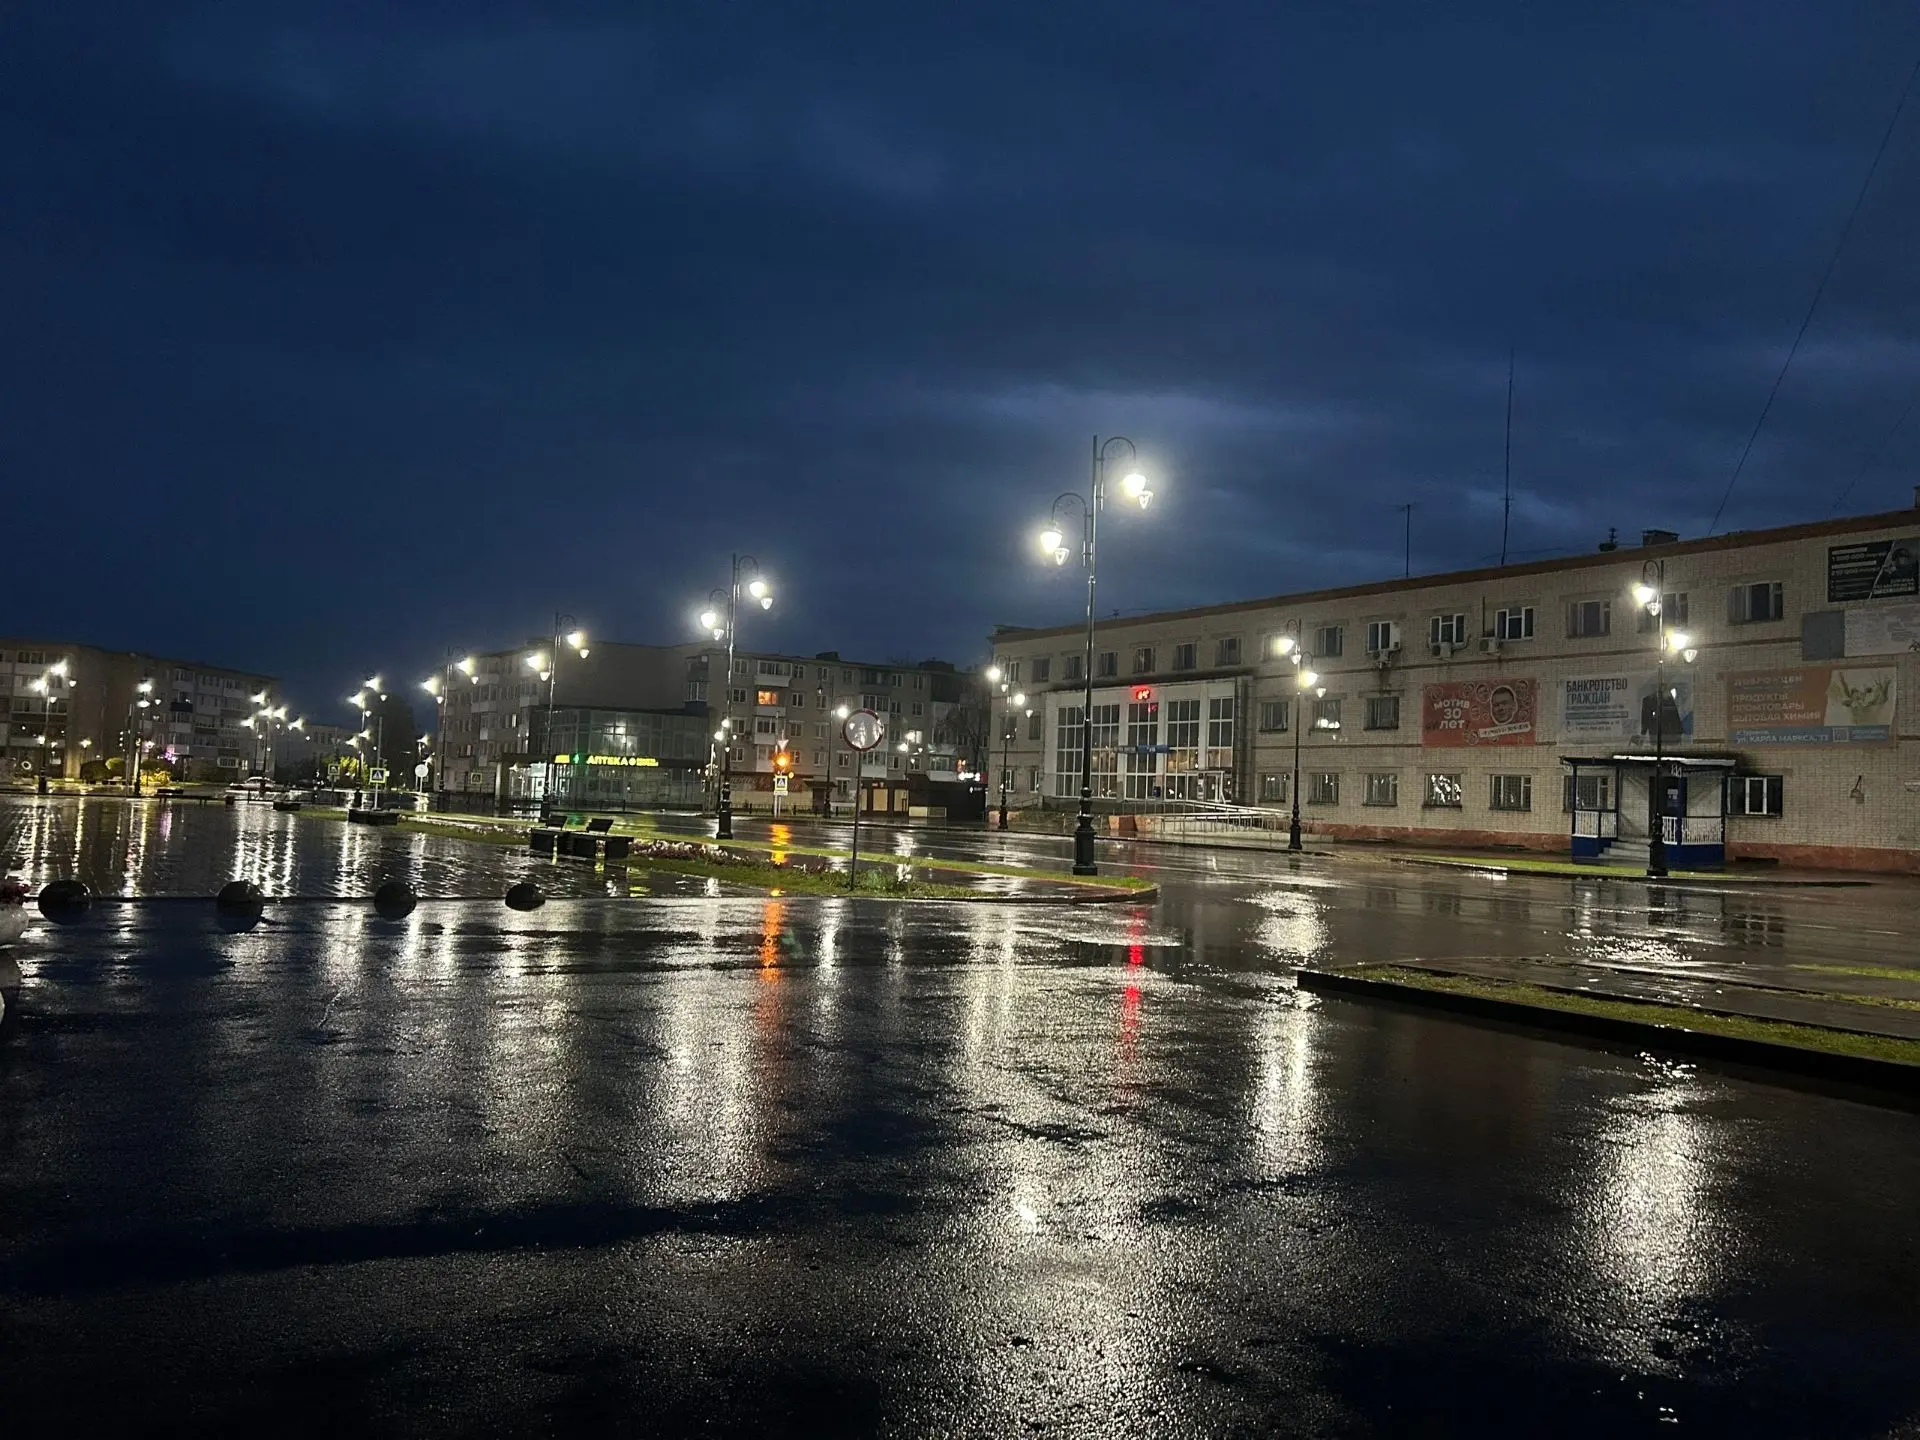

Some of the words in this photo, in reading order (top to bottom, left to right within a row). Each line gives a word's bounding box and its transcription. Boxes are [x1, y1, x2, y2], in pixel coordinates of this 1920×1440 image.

[1566, 678, 1629, 692] БАНКРОТСТВО
[1567, 691, 1611, 705] ГРАЖДАН
[1443, 707, 1462, 719] 30
[1784, 710, 1821, 721] ХИМИЯ
[586, 754, 629, 766] АПТЕКА
